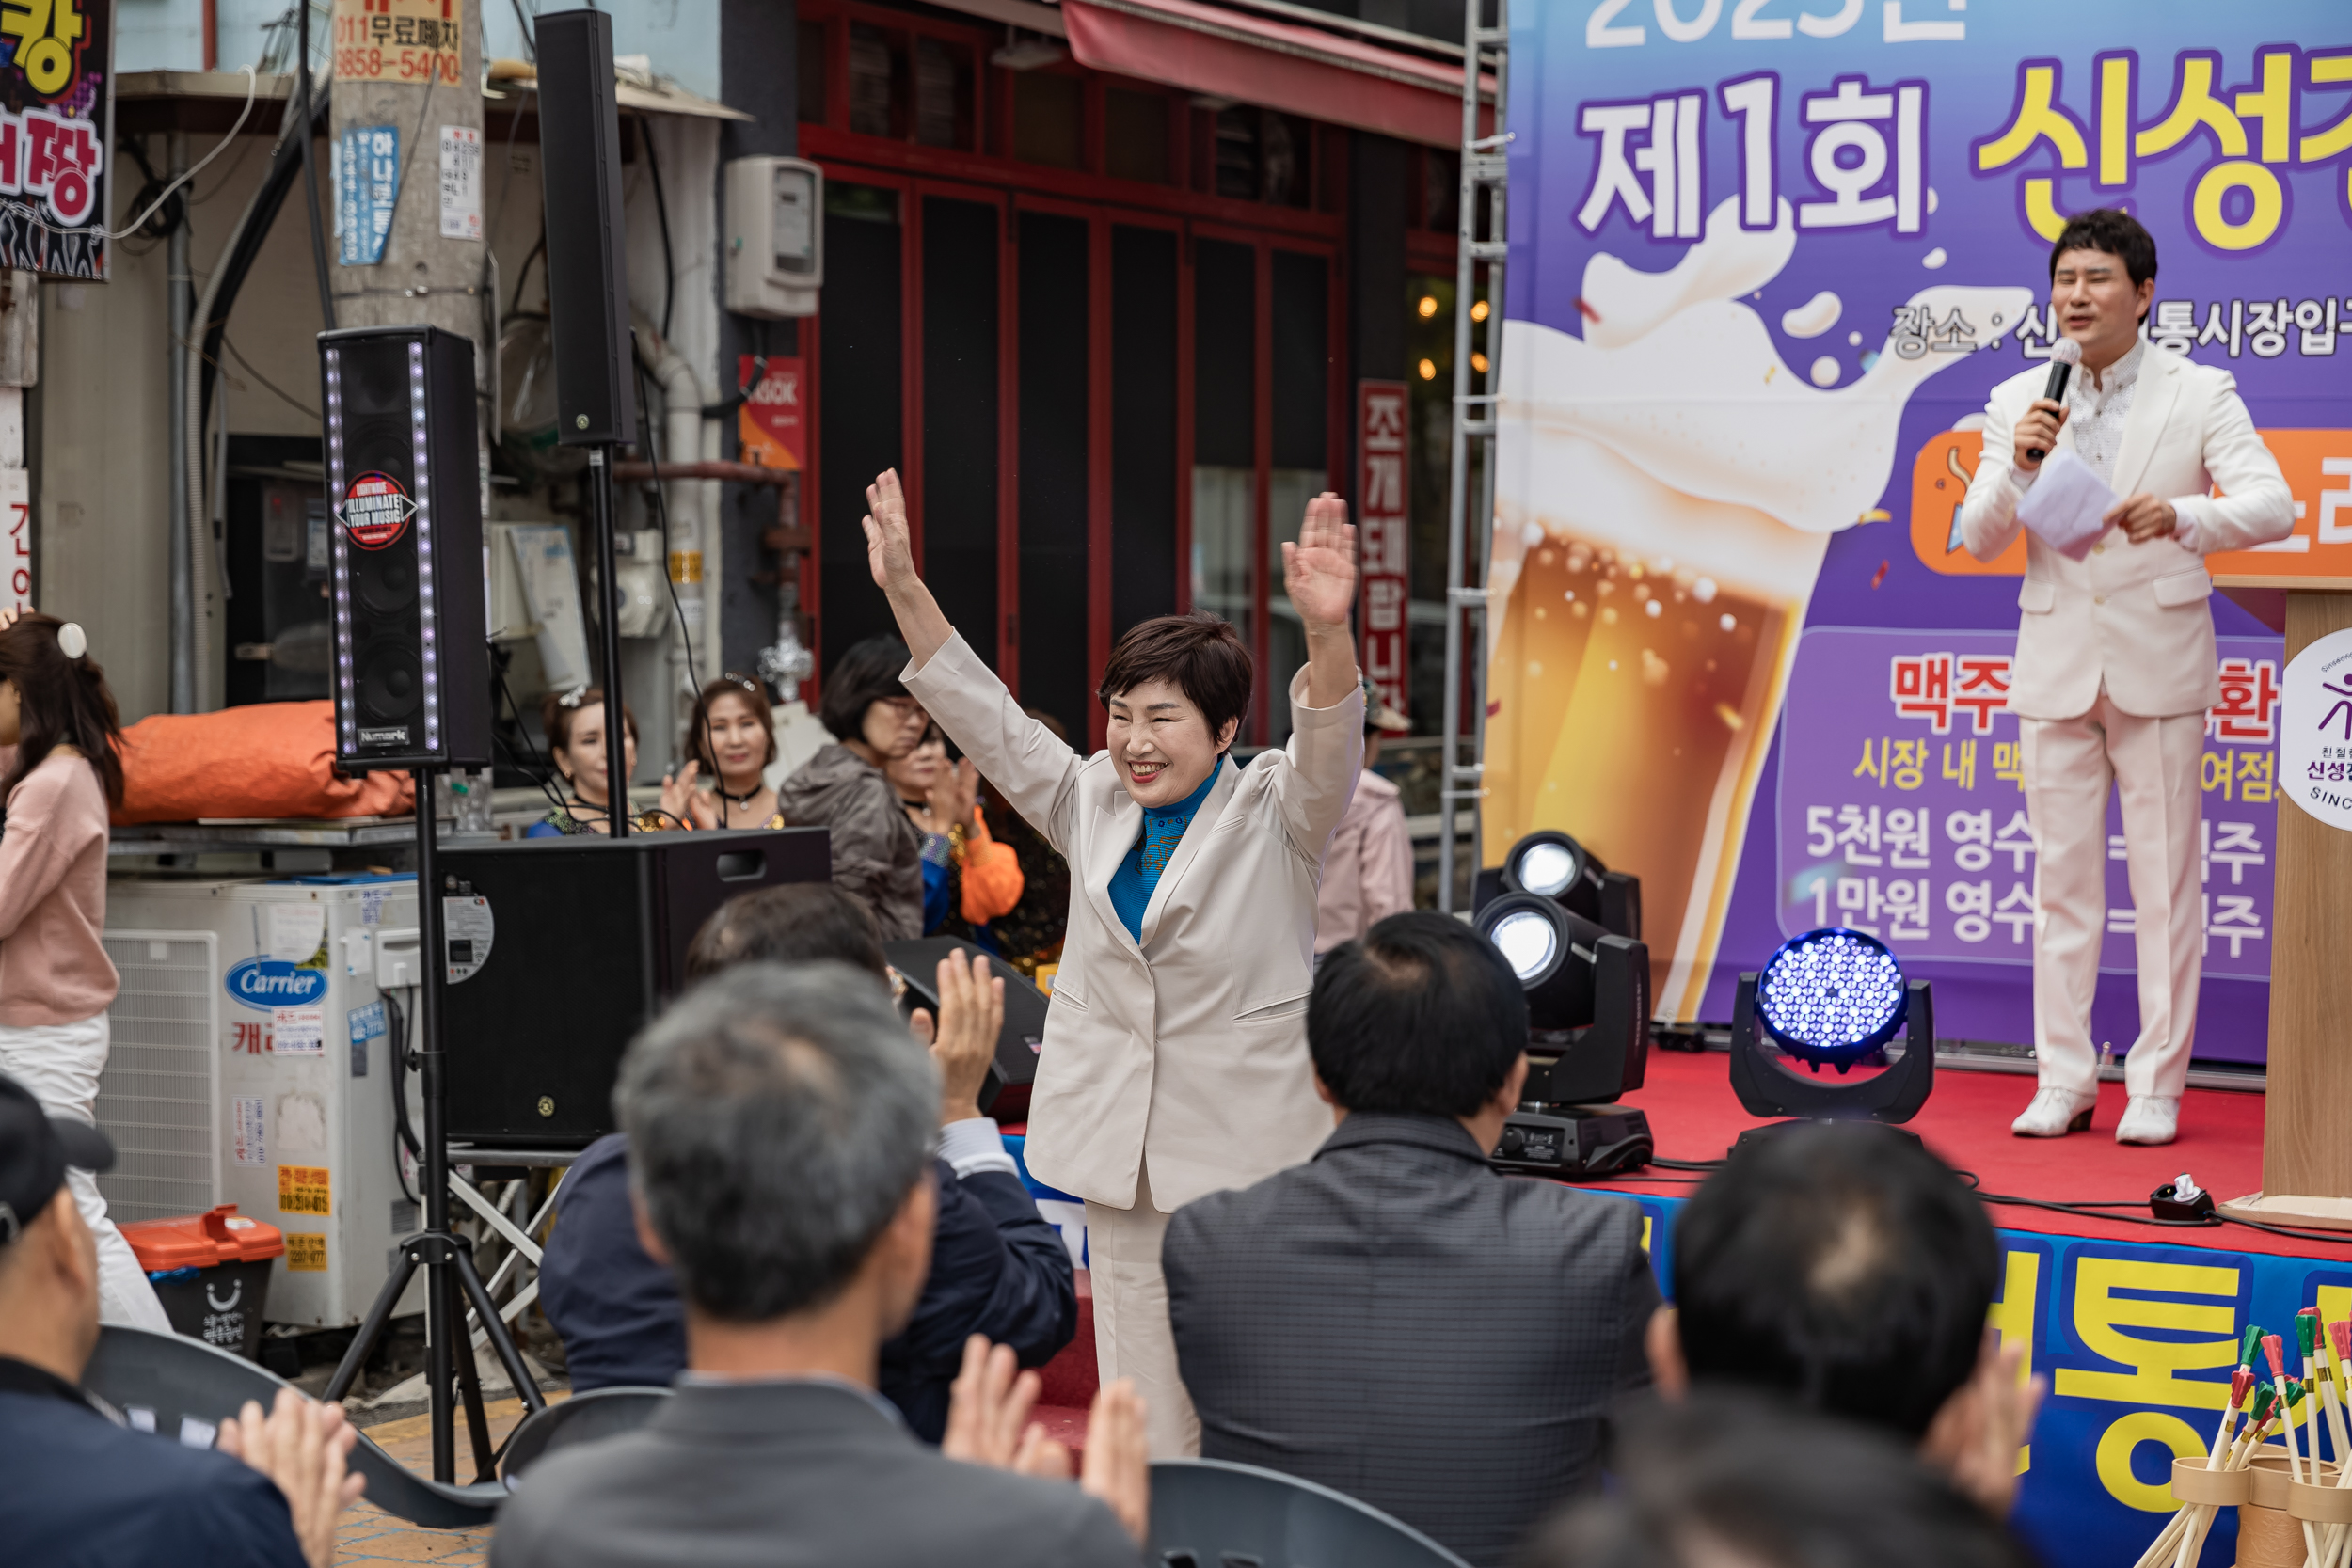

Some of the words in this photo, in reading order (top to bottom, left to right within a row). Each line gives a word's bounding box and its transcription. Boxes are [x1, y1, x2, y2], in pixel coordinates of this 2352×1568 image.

[1577, 77, 1923, 238] 제1회
[1892, 305, 1975, 359] 장소
[348, 493, 400, 515] ILLUMINATE
[350, 511, 372, 528] YOUR
[371, 509, 402, 525] MUSIC
[1852, 736, 1930, 791] 시장
[1941, 738, 1977, 791] 내
[1806, 804, 1931, 869] 5천원
[1808, 875, 1931, 942] 1만원
[239, 969, 318, 996] Carrier
